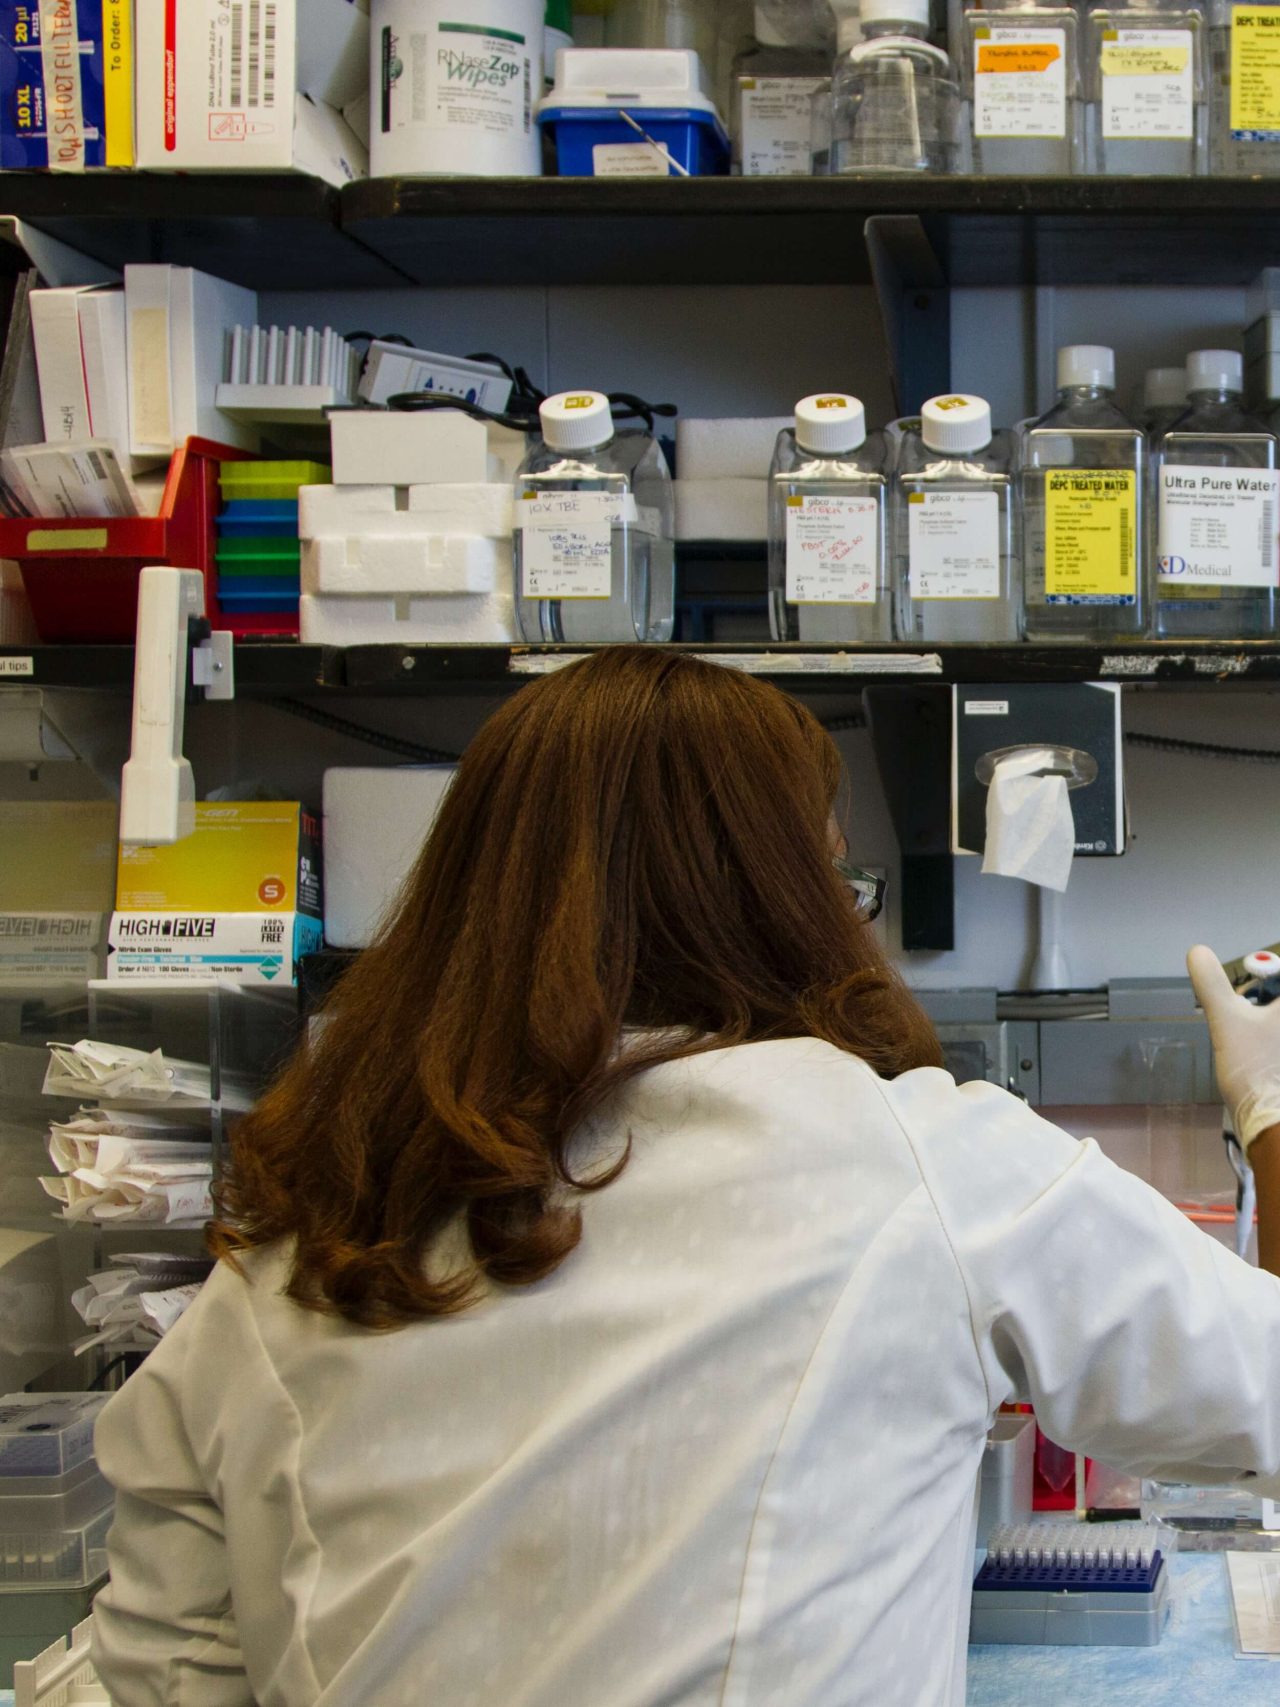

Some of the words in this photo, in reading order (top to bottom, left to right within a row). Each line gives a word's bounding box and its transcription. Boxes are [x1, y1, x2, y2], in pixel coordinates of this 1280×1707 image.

[1236, 16, 1254, 26] DEPC
[16, 23, 27, 43] 20
[111, 9, 121, 52] Order:
[112, 57, 121, 71] To
[166, 49, 175, 98] eppendorf
[446, 63, 507, 88] Wipes
[18, 85, 30, 105] XL
[55, 73, 76, 134] SHORT
[18, 106, 30, 128] 10
[166, 98, 175, 134] original
[1050, 480, 1068, 491] DEPC
[1071, 480, 1103, 491] TREATED
[1104, 481, 1129, 491] WATER
[1165, 476, 1196, 489] Ultra
[1202, 477, 1233, 490] Pure
[1236, 478, 1277, 492] Water
[930, 494, 951, 504] gibco
[1187, 564, 1232, 576] Medical
[8, 660, 28, 672] tips
[264, 885, 279, 899] S
[119, 920, 161, 936] HIGH
[174, 919, 216, 937] FIVE
[262, 934, 282, 943] FREE
